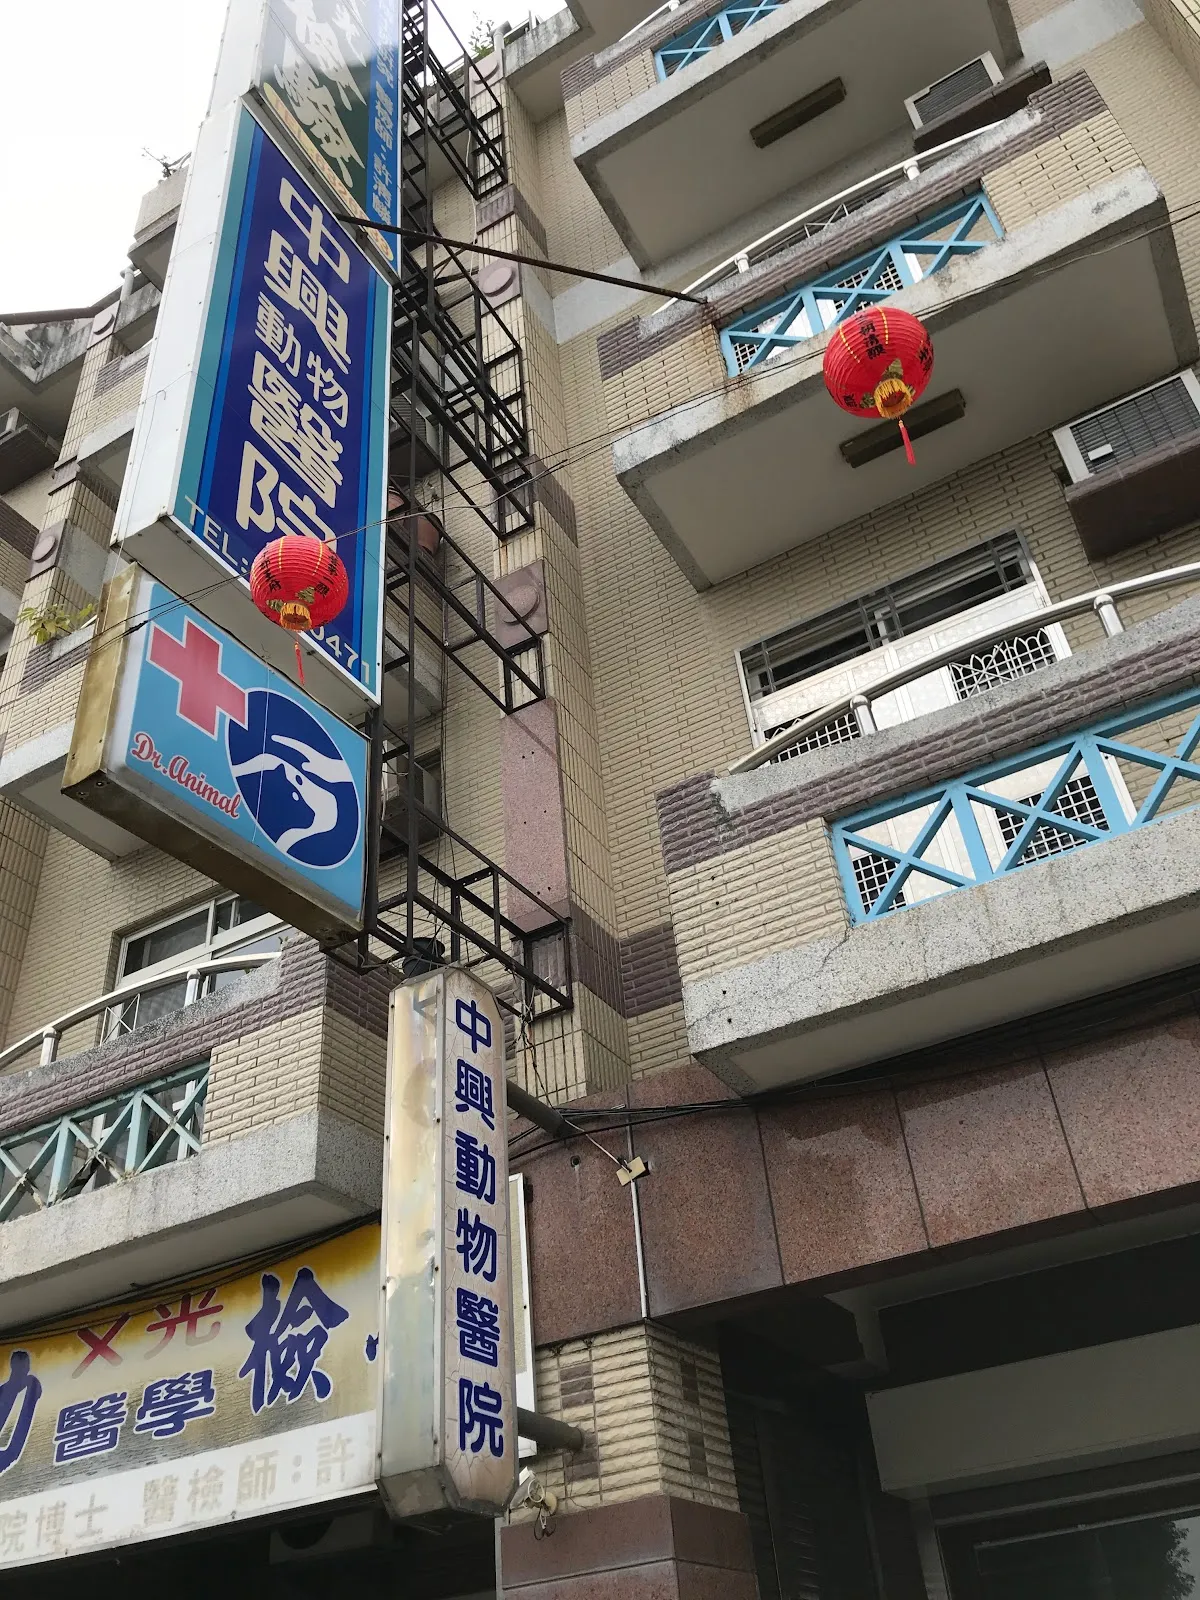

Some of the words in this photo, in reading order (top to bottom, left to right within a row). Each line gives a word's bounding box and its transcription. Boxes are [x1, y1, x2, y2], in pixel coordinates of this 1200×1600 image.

[455, 999, 504, 1458] 中興動物醫院
[239, 1267, 379, 1414] 檢
[54, 1370, 215, 1462] 醫學
